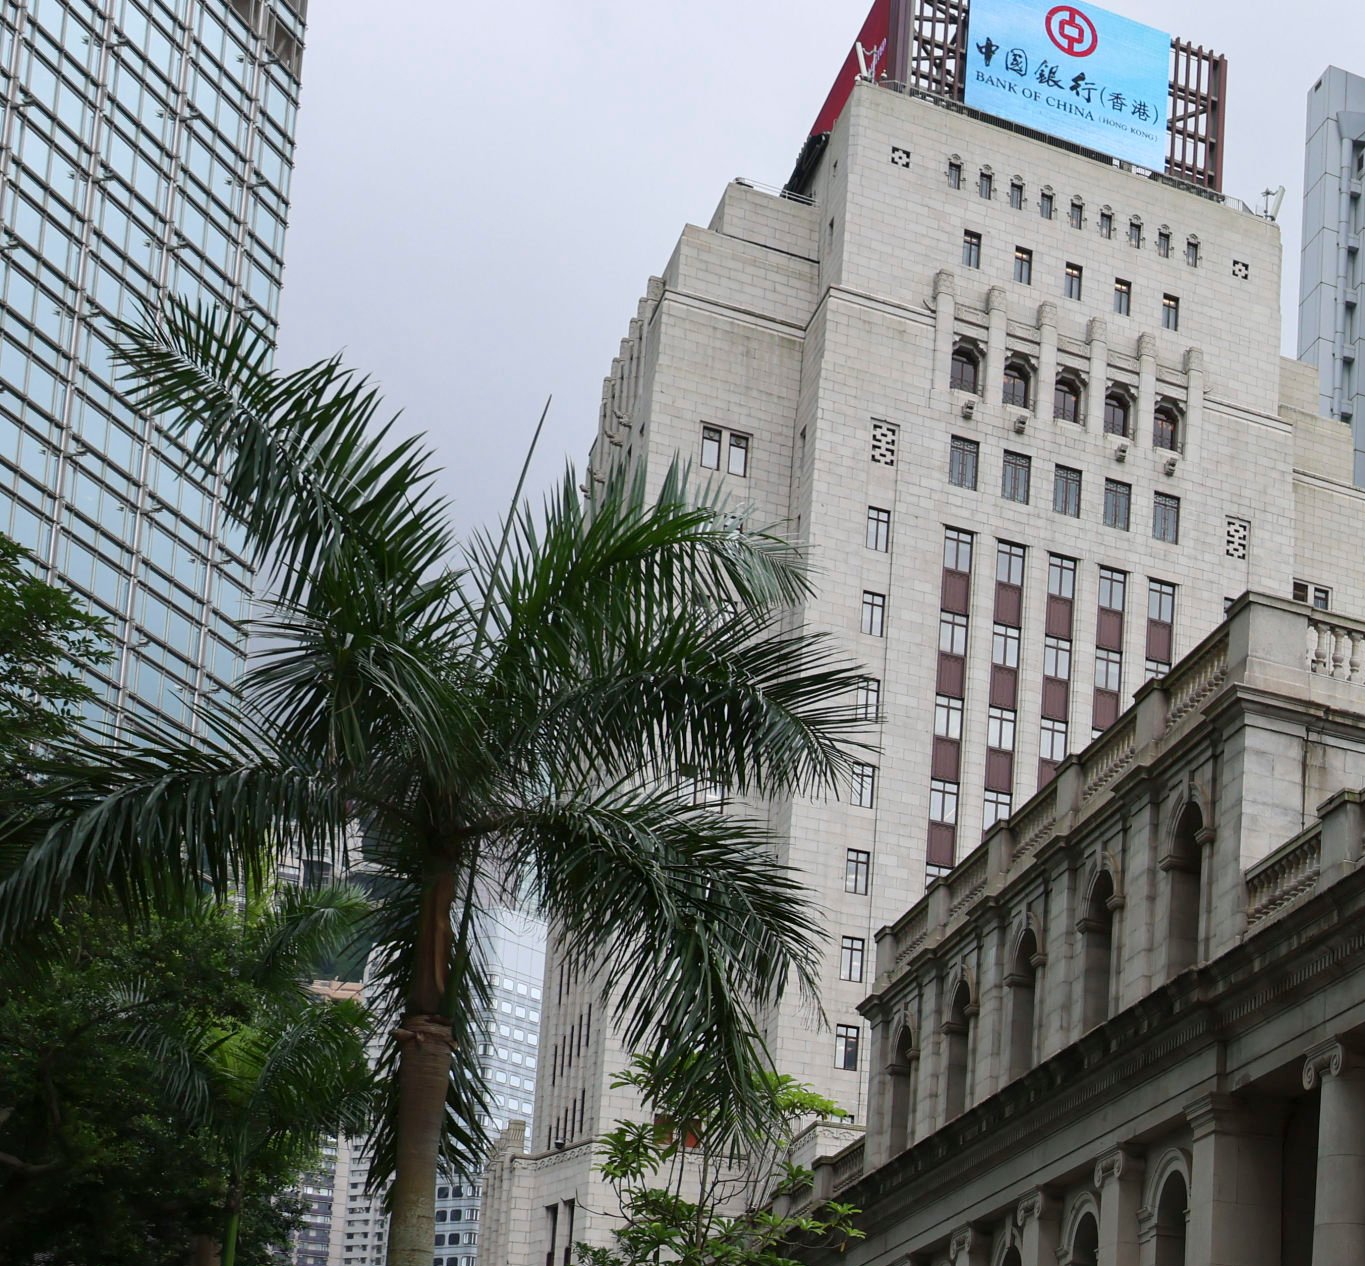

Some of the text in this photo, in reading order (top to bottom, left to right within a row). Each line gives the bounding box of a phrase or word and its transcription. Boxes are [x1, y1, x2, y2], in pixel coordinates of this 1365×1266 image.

[975, 70, 1159, 142] BANK OF CHINA (HONG KONG)
[976, 36, 1159, 125] 中國銀行(香港)
